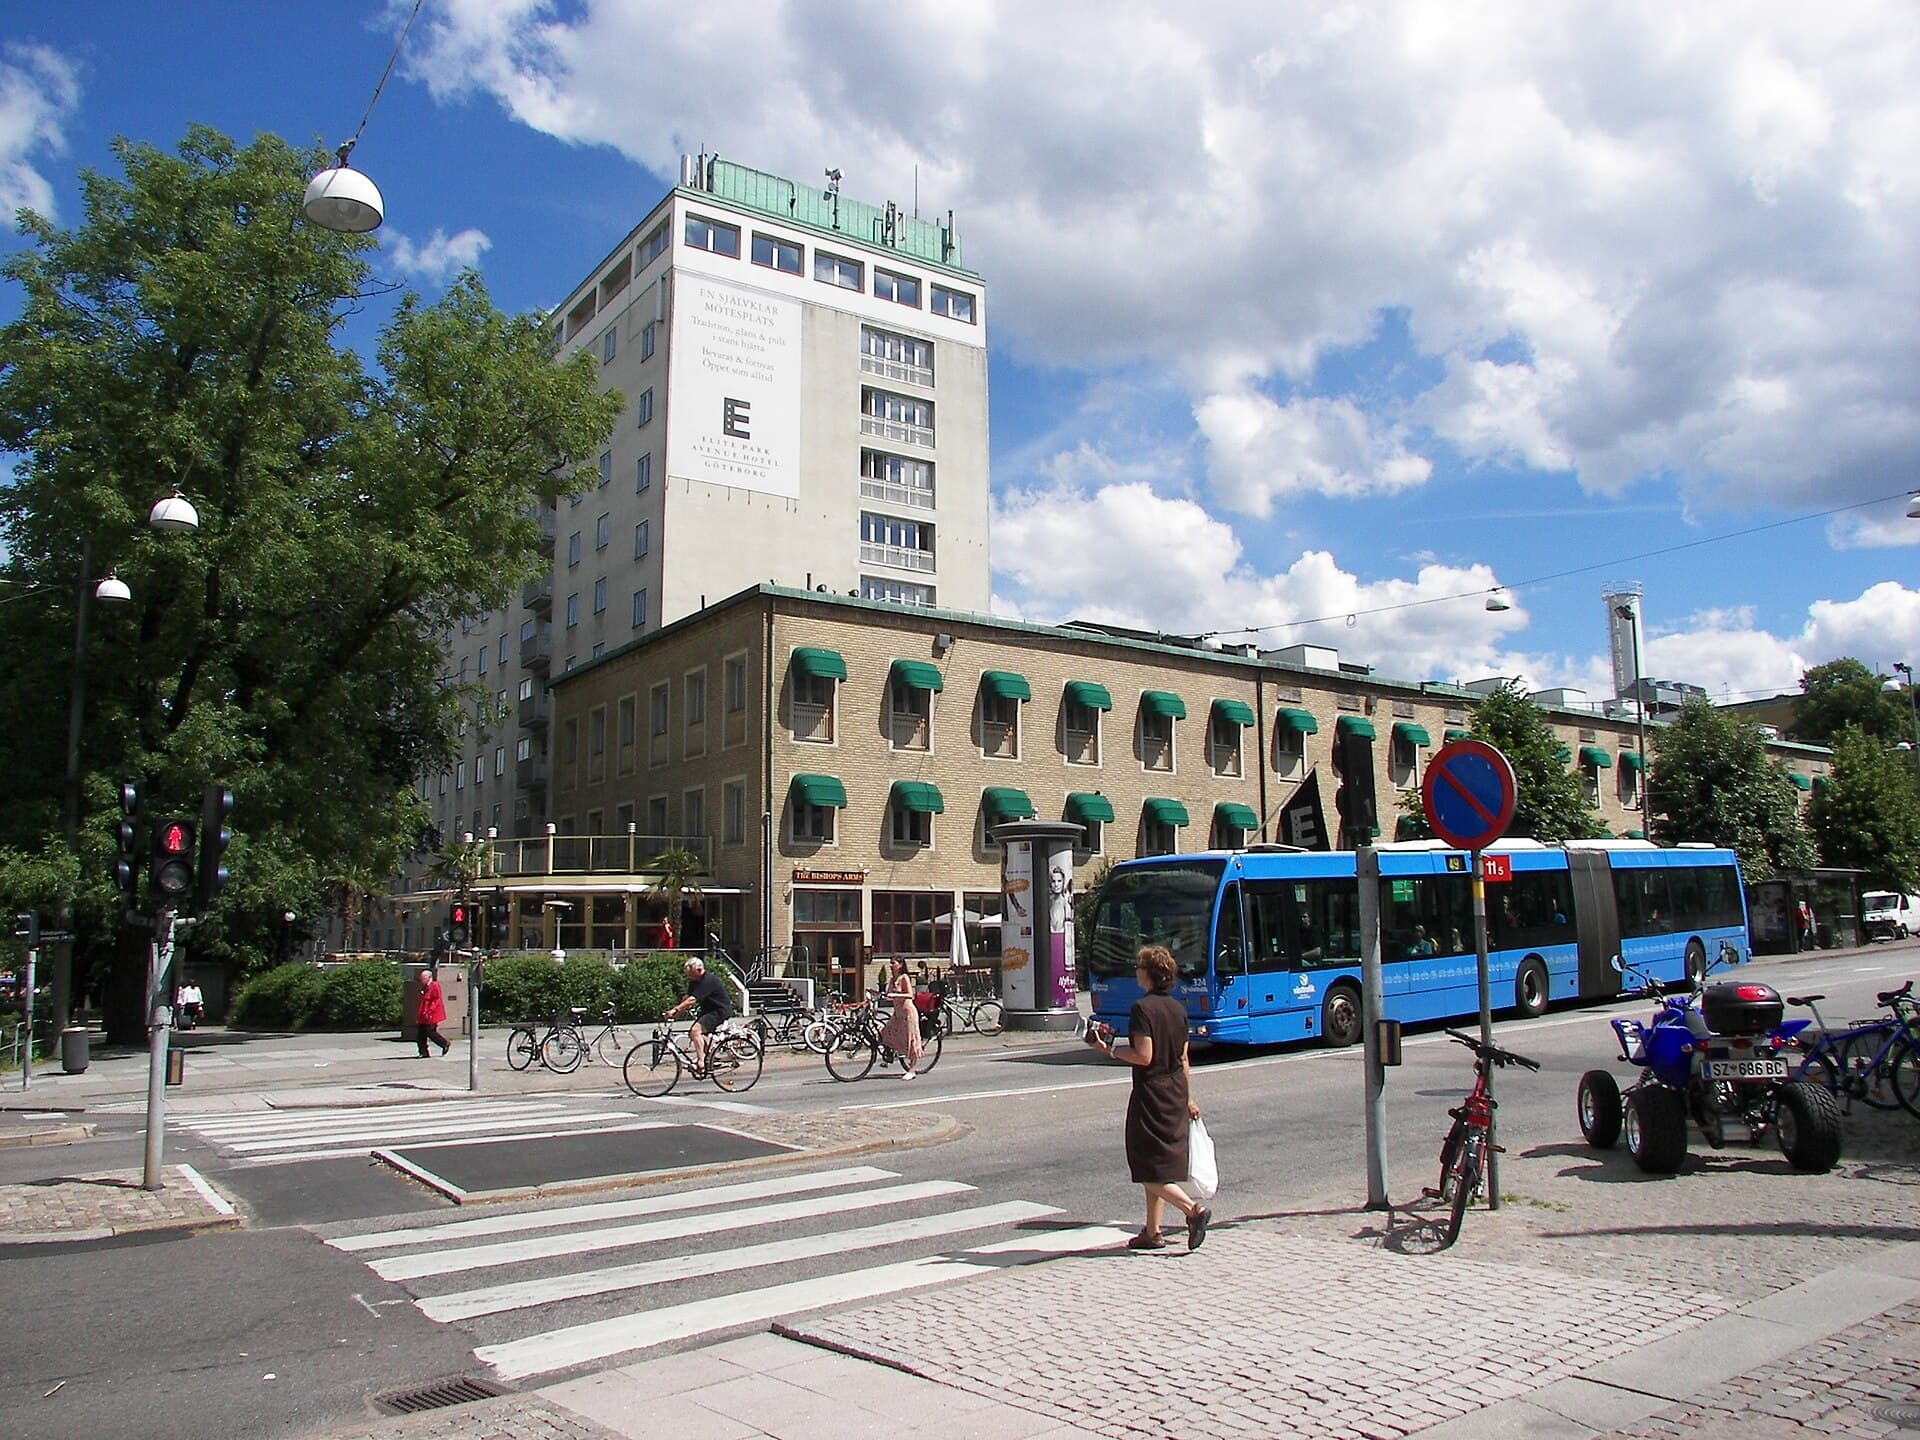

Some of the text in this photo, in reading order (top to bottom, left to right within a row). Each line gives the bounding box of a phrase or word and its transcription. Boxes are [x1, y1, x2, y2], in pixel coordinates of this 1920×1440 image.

[700, 288, 714, 299] EN
[723, 396, 751, 440] E
[702, 435, 770, 455] ELITE PARK
[692, 445, 779, 467] AVENUE HOTEL
[1192, 978, 1207, 987] 324
[1712, 1063, 1730, 1076] SZ
[1766, 1061, 1783, 1075] BC
